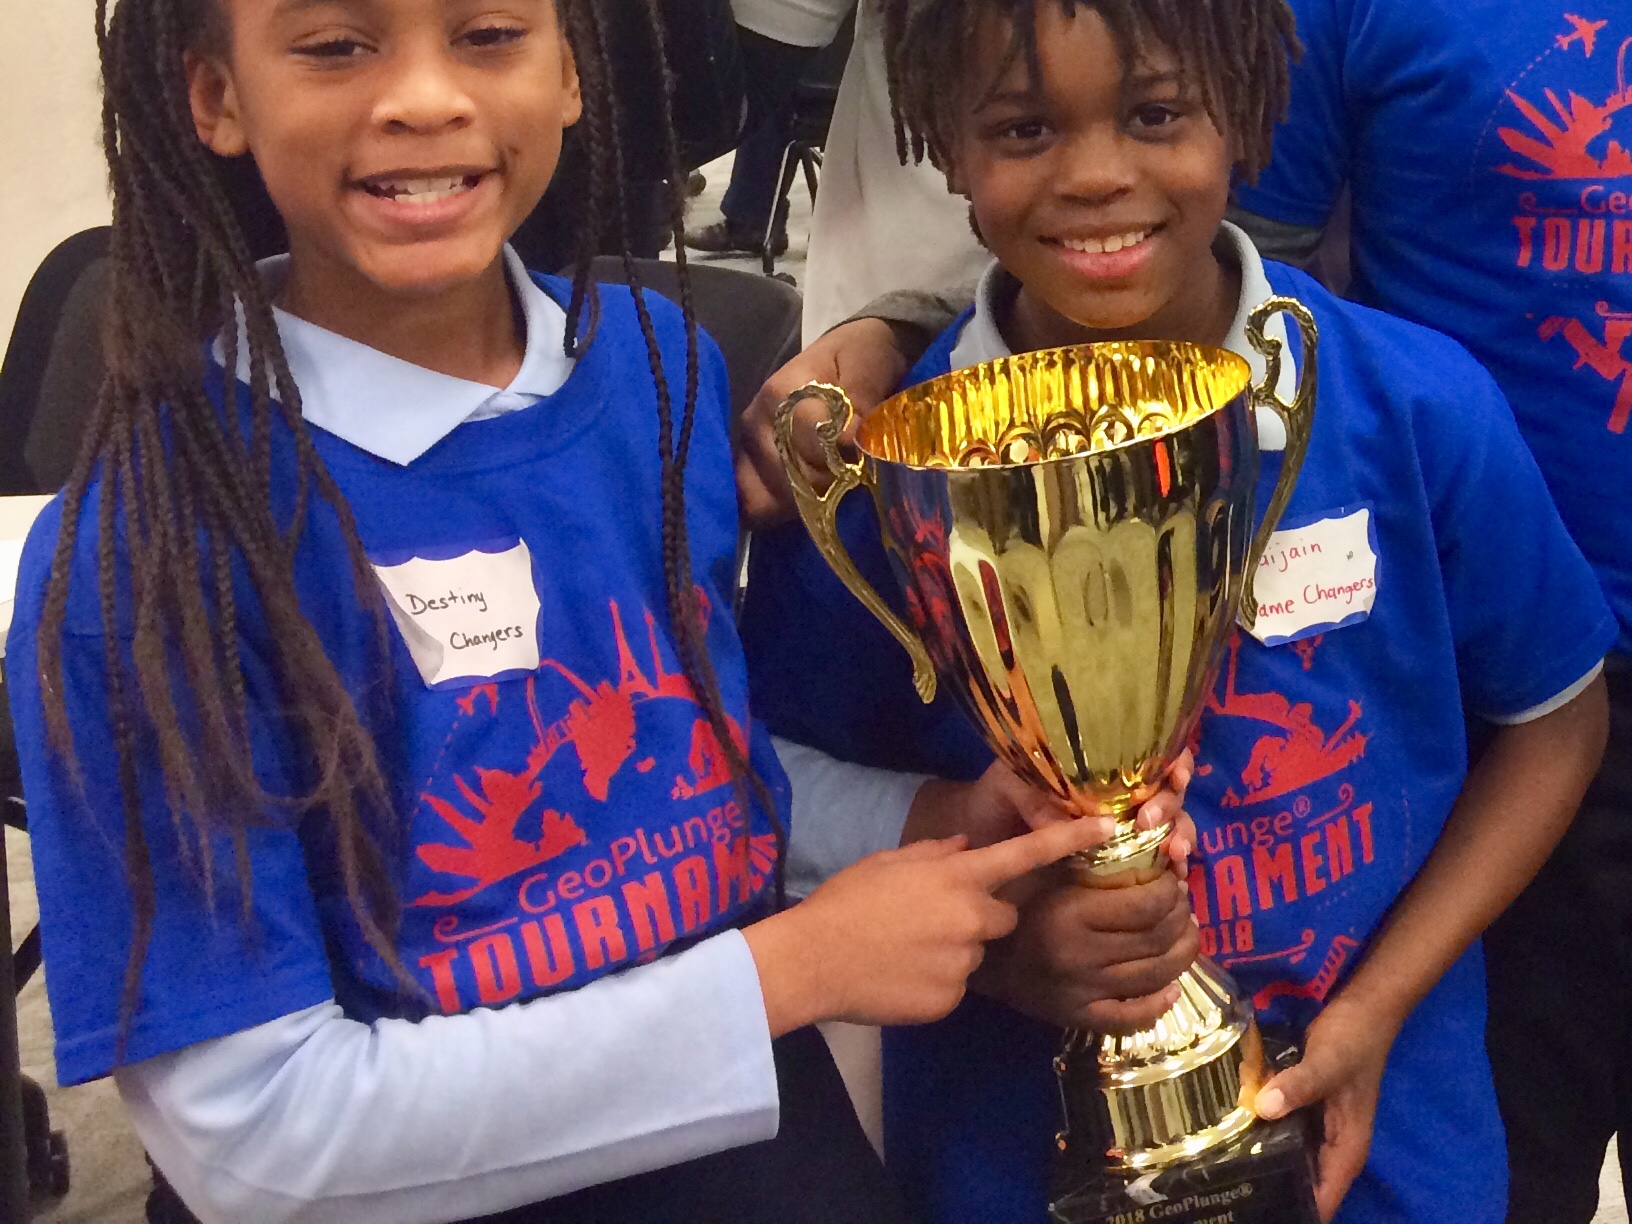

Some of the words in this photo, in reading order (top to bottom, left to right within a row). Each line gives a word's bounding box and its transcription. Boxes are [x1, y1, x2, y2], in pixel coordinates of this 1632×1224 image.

[1260, 538, 1321, 572] aijain
[405, 590, 487, 615] Destiny
[1259, 599, 1295, 617] ame
[1303, 577, 1373, 604] Changers
[450, 625, 523, 651] Changers
